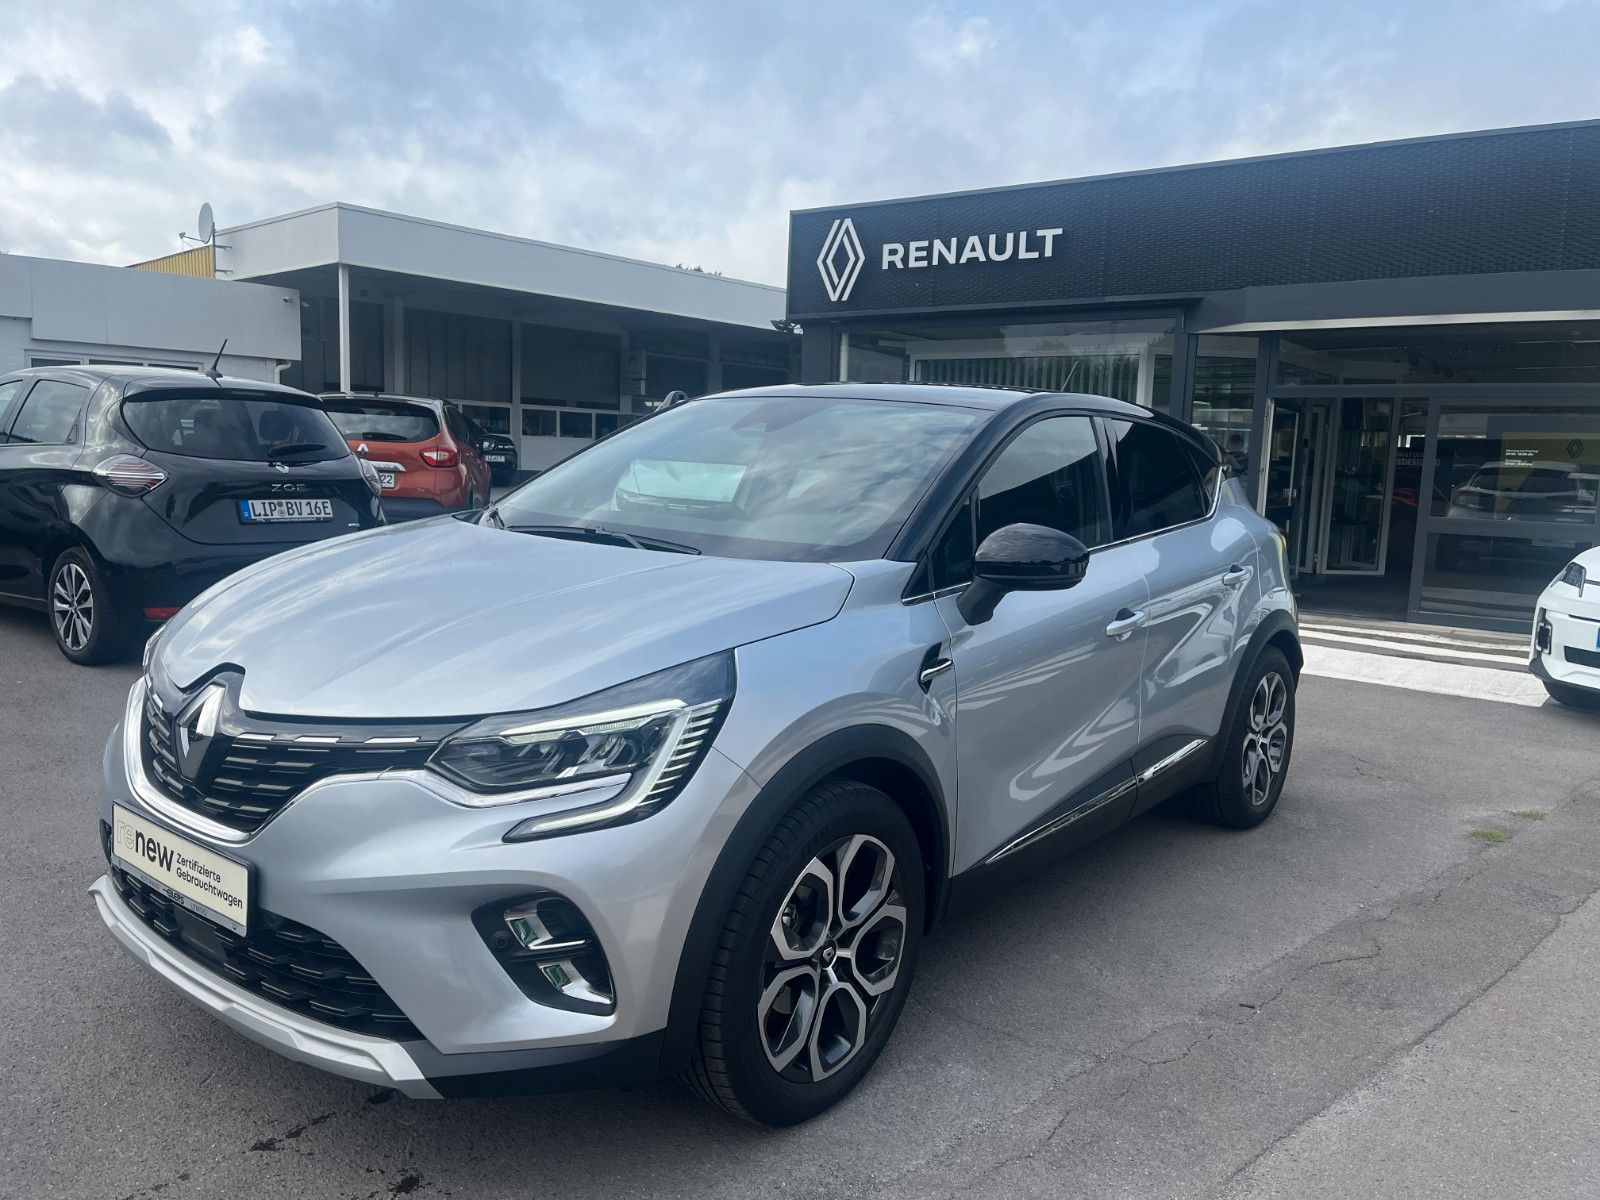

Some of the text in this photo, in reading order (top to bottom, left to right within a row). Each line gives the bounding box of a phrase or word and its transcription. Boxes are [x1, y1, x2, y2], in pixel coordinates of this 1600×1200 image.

[882, 228, 1063, 270] RENAULT
[271, 484, 307, 492] ZOE
[251, 501, 277, 517] LIP
[305, 501, 332, 516] 16E
[176, 852, 222, 883] Zertifizierte
[176, 867, 243, 909] Gebrauchtwagen
